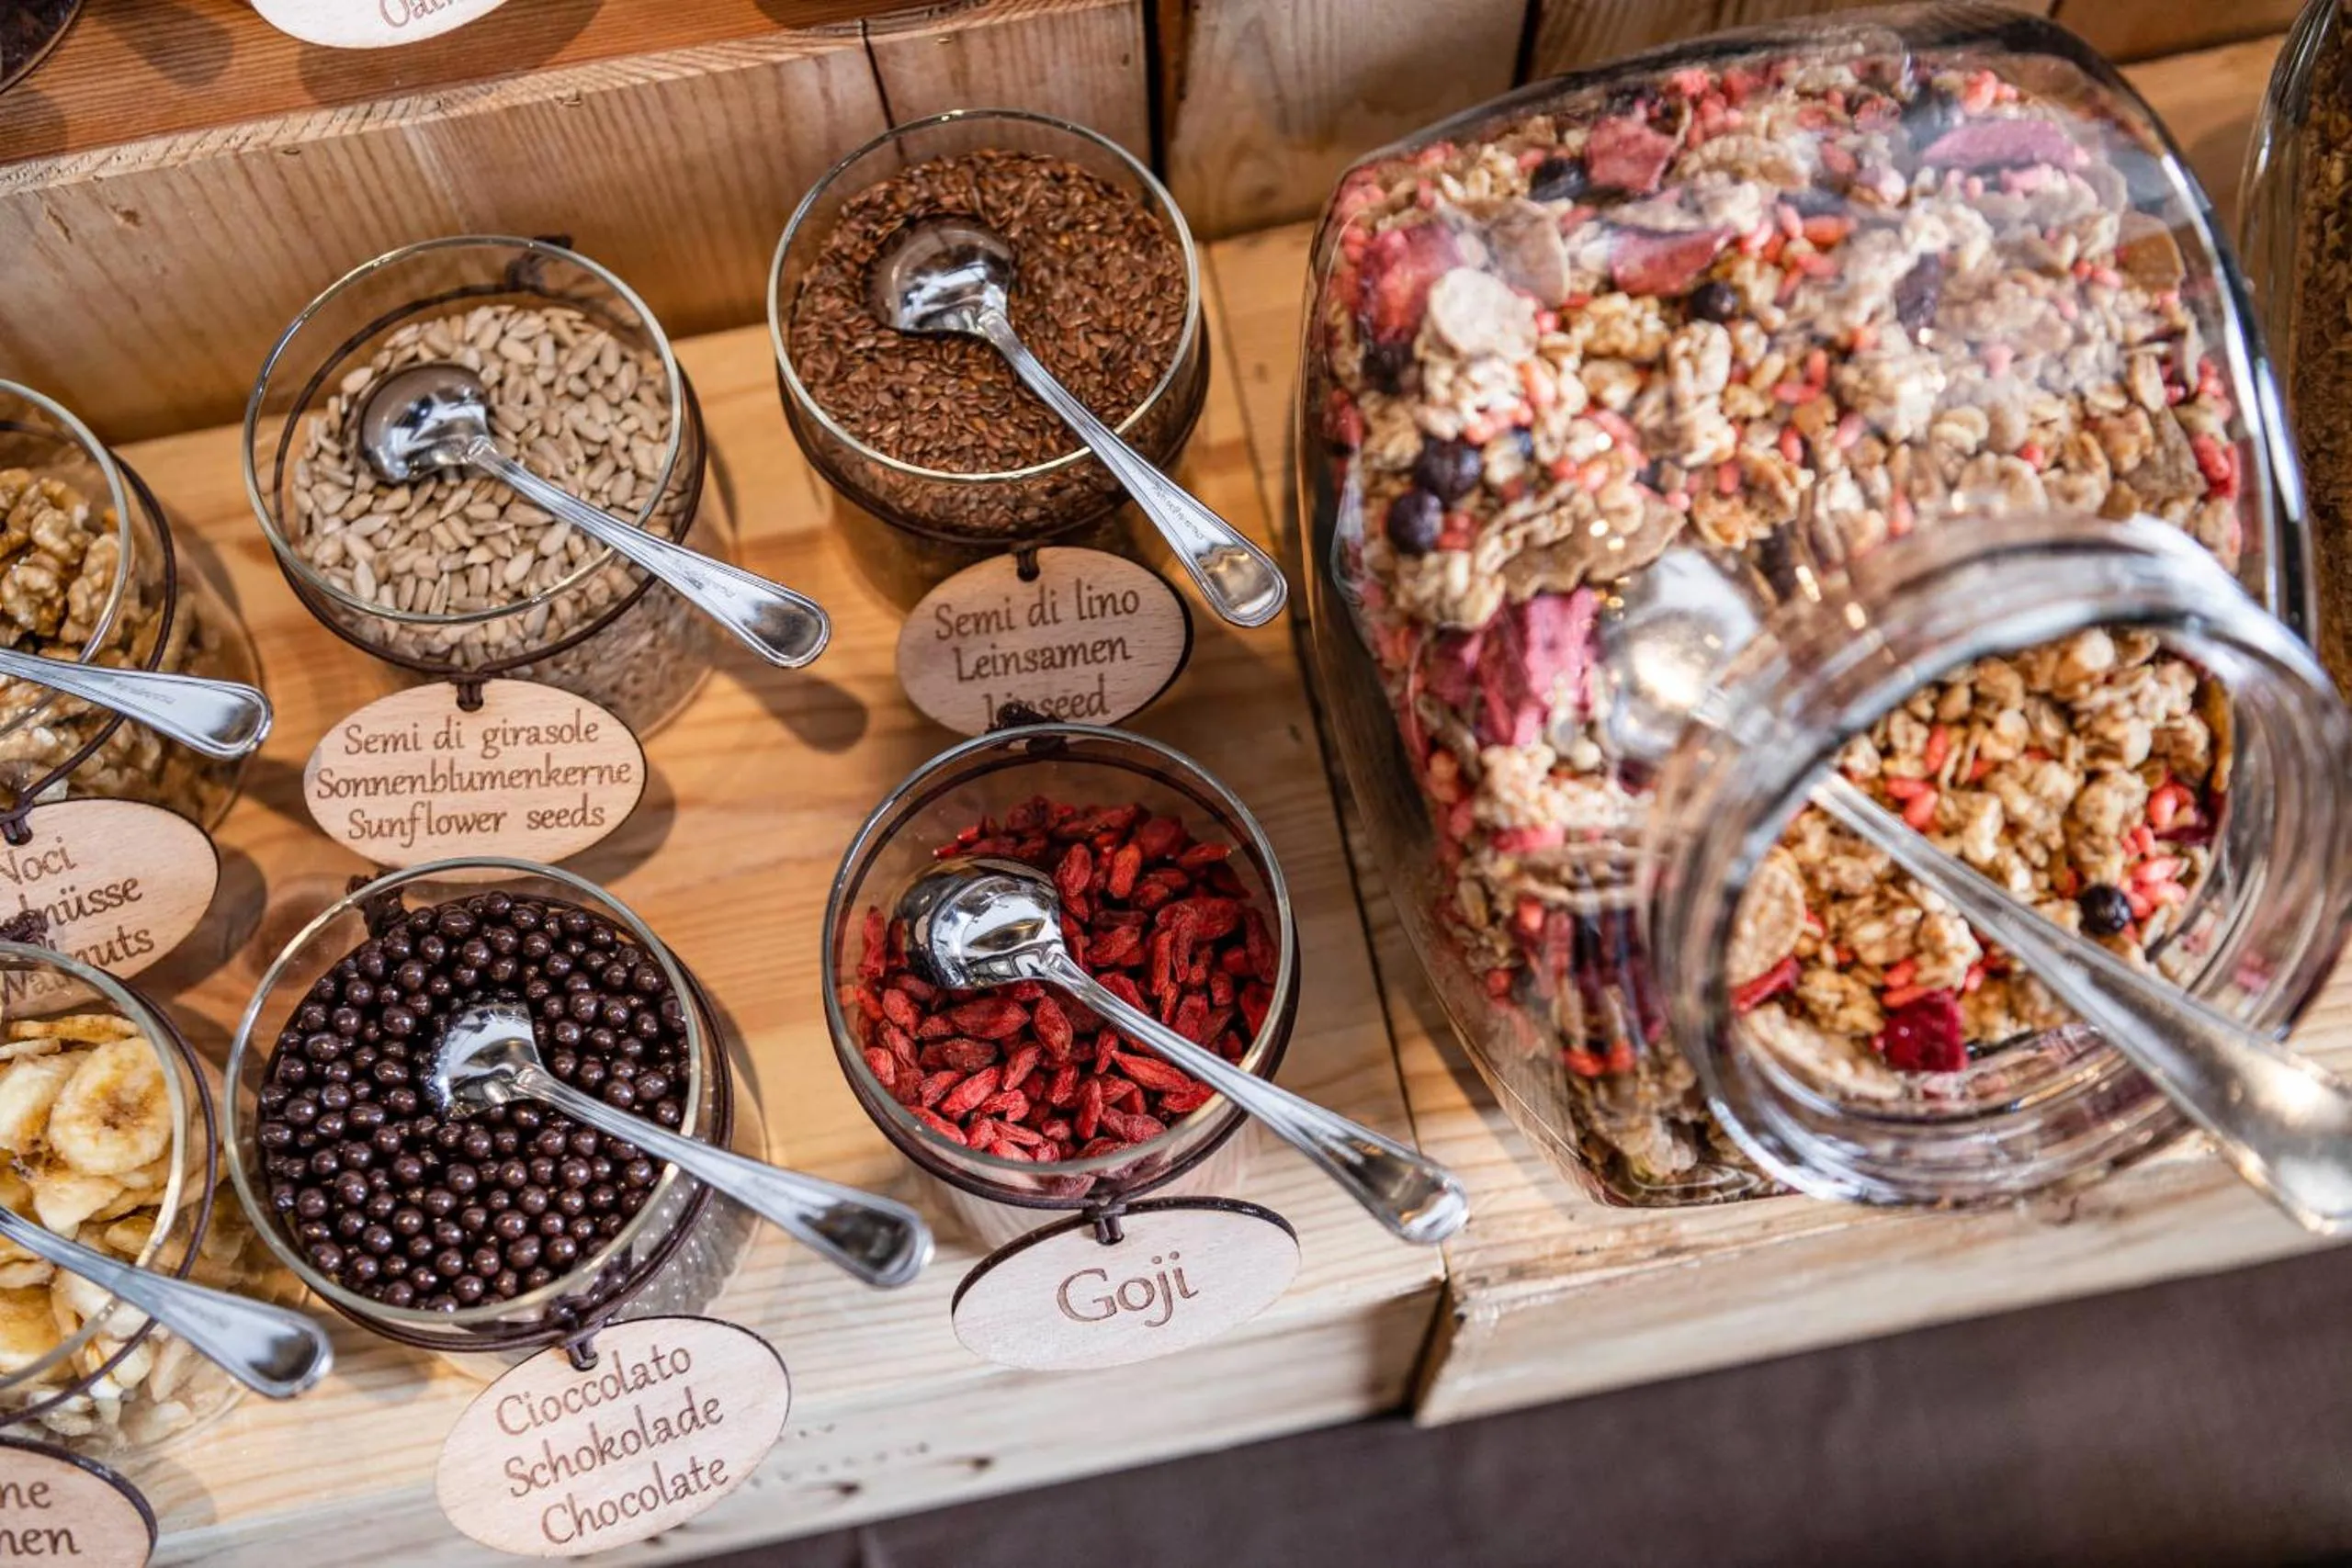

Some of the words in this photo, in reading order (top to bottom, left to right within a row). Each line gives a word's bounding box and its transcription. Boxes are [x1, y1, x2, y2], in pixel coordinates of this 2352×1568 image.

[934, 597, 1017, 640] Semi
[1027, 584, 1060, 627] di
[1076, 578, 1140, 621] lino
[952, 636, 1132, 682] Leinsamen
[345, 722, 423, 755] Semi
[433, 715, 465, 750] di
[481, 708, 600, 759] girasole
[317, 752, 633, 799] Sonnenblumenkerne
[348, 802, 508, 847] Sunflower
[526, 794, 606, 830] seeds
[1057, 1251, 1199, 1326] Goji
[496, 1344, 691, 1436] Cioccolato
[504, 1386, 724, 1497] Schokolade
[541, 1456, 729, 1545] Chocolate
